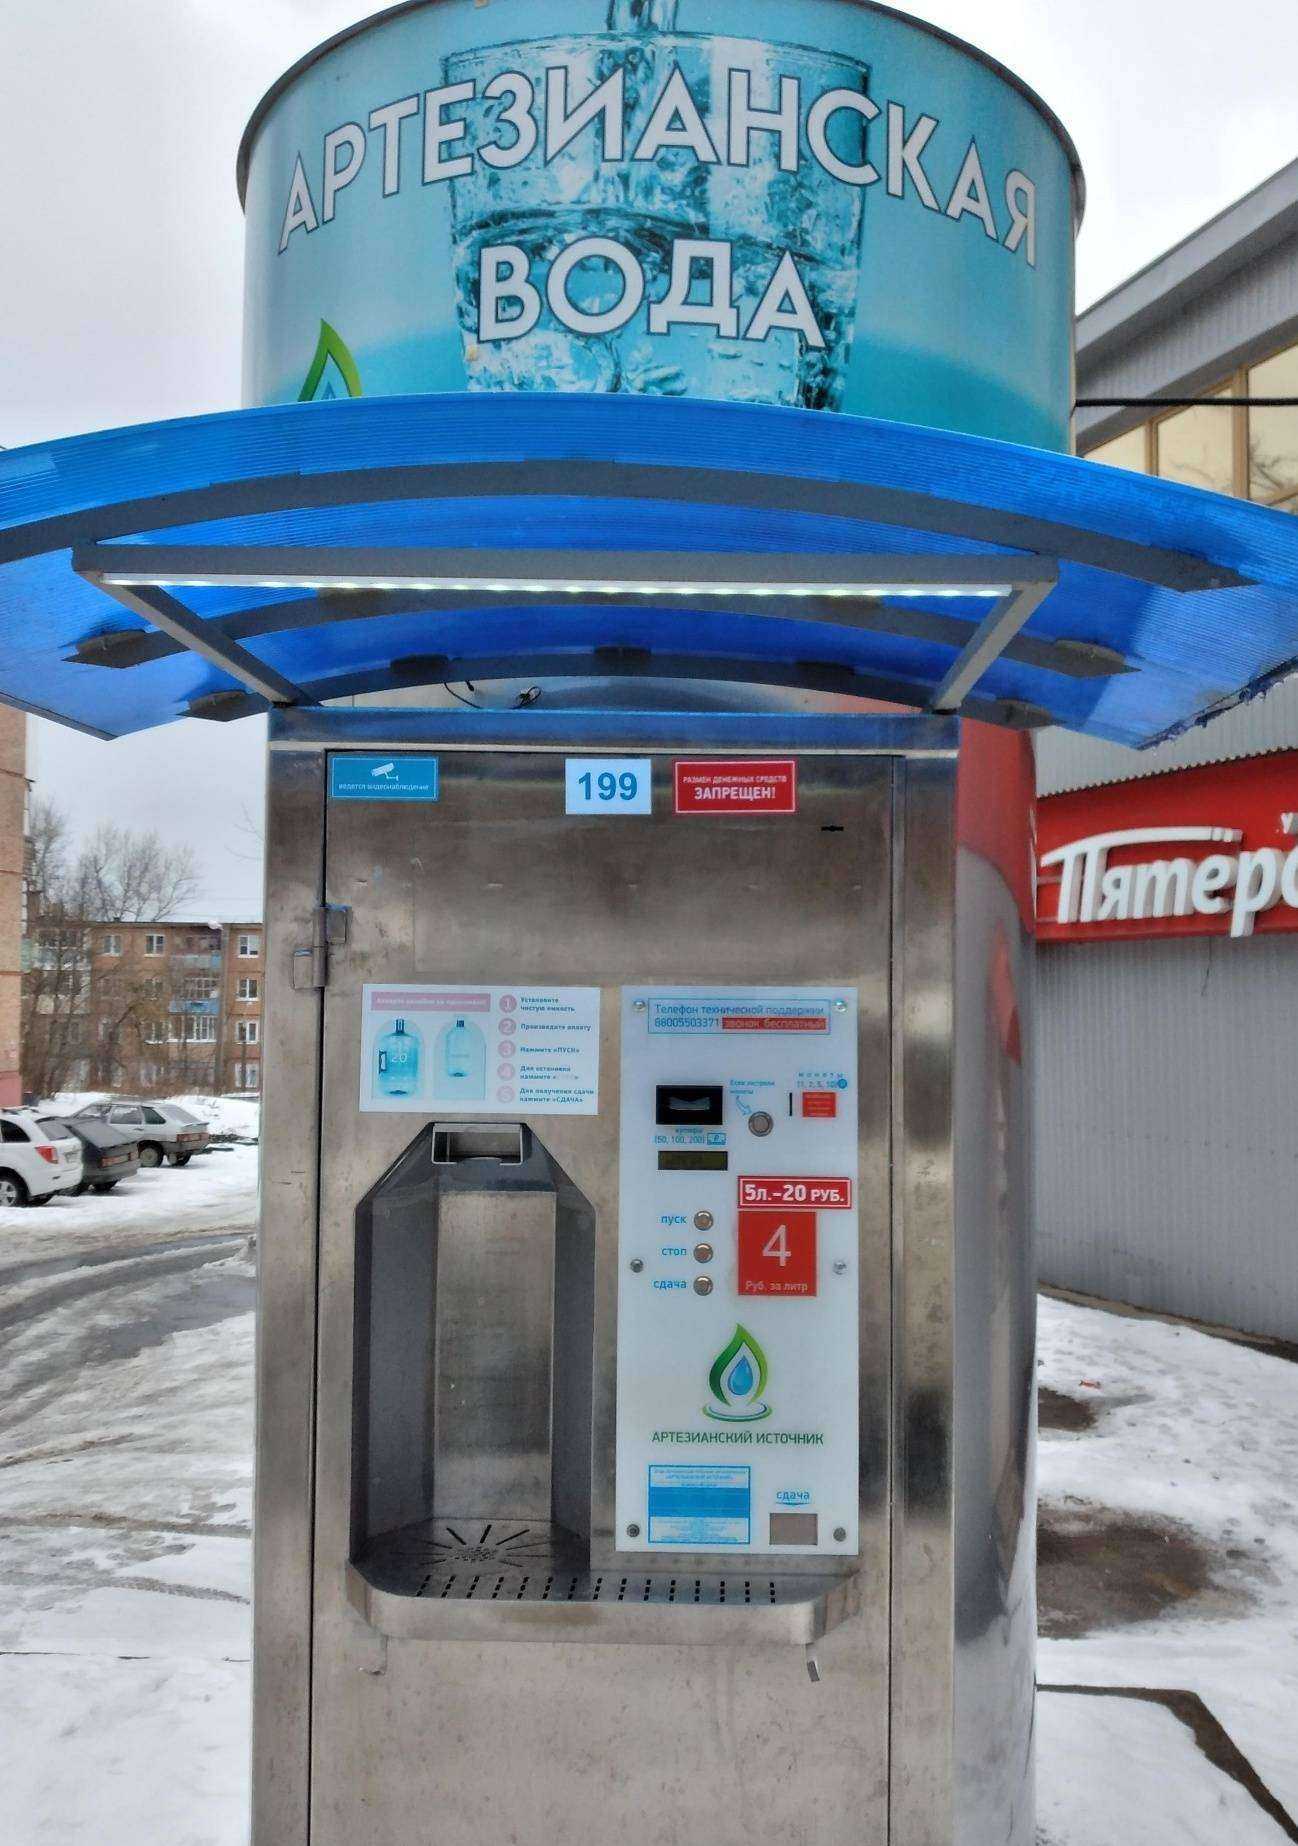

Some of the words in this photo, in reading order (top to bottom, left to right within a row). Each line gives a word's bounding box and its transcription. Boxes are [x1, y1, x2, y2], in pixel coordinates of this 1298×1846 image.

[277, 63, 1038, 269] АРТЕЗИАНСКАЯ
[478, 236, 826, 348] ВОДА
[578, 772, 638, 801] 199
[694, 786, 776, 801] ЗАПРЕЩЕН!
[655, 1003, 699, 1015] Телефон
[701, 1004, 764, 1015] технической
[810, 1188, 846, 1202] РУБ.
[661, 1215, 687, 1226] пуск
[661, 1247, 687, 1256] стоп
[762, 1224, 792, 1267] 4
[653, 1279, 688, 1289] сдача
[769, 1282, 782, 1291] за
[784, 1282, 808, 1293] литр
[651, 1430, 752, 1444] АРТЕЗИАНСКИЙ
[756, 1432, 825, 1445] ИСТОЧНИК
[776, 1490, 811, 1501] сдача
